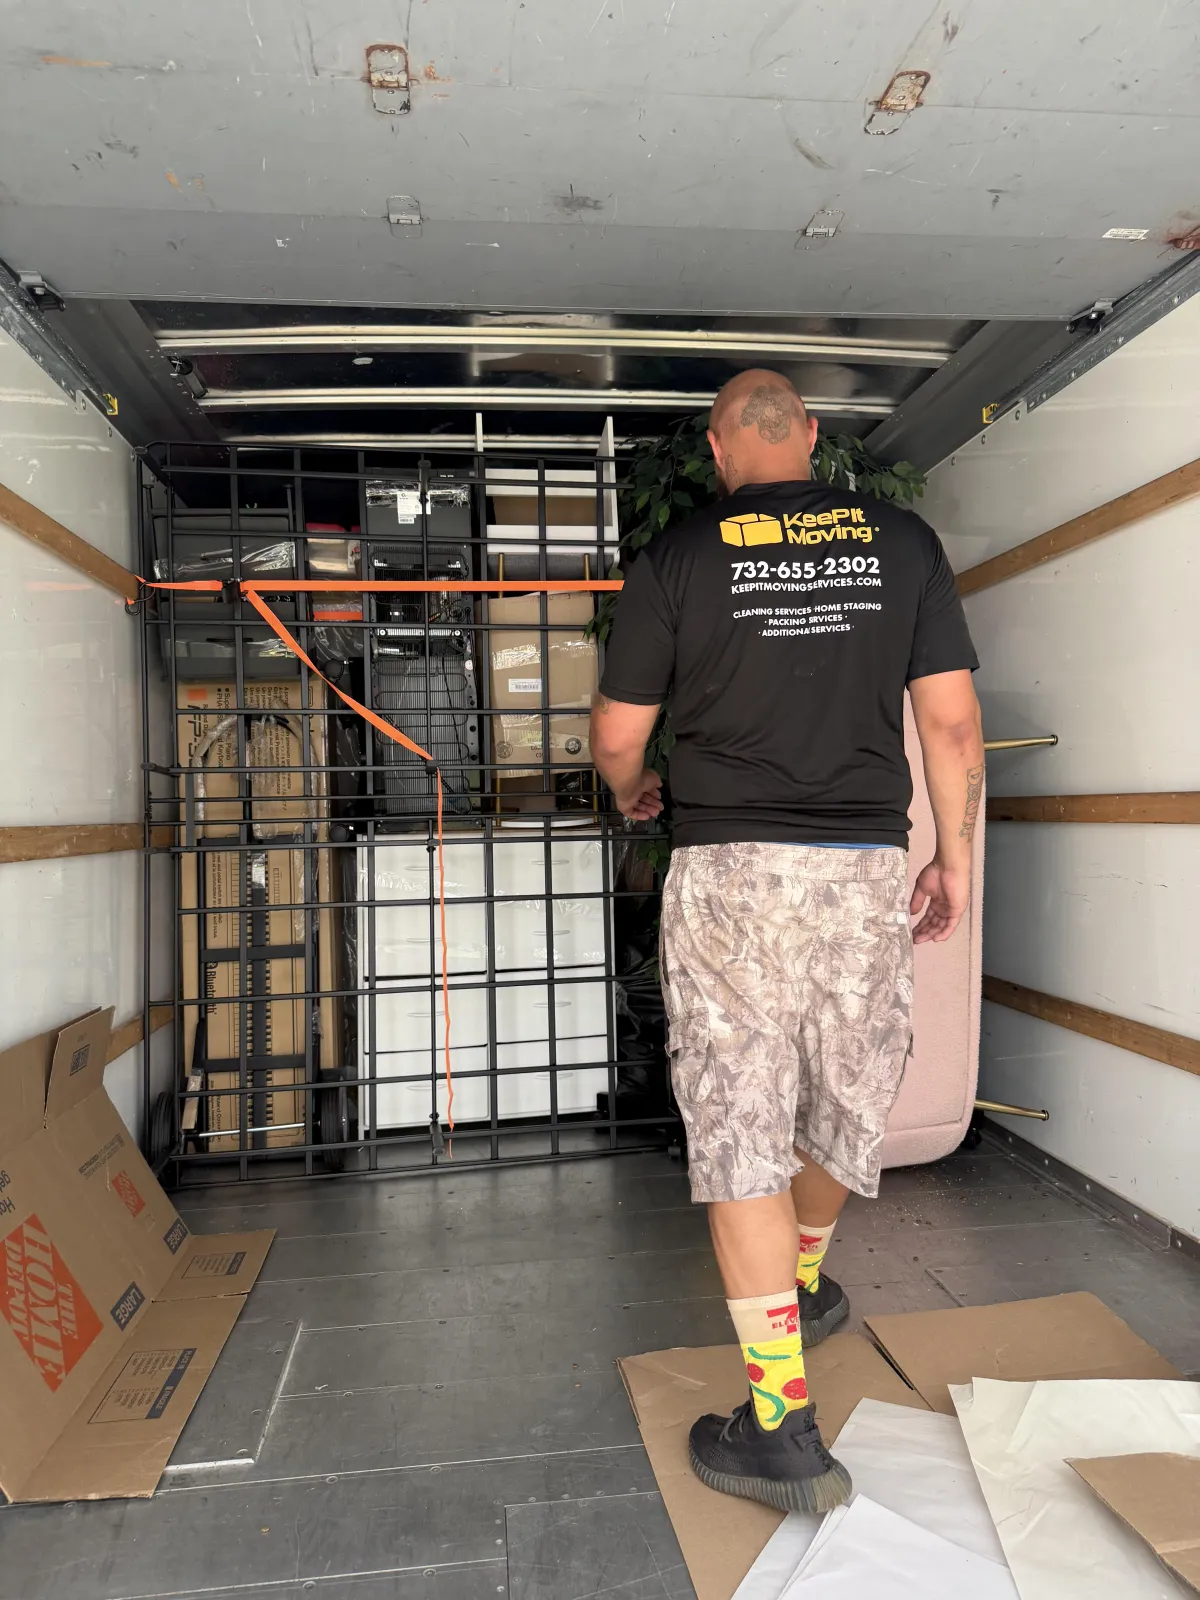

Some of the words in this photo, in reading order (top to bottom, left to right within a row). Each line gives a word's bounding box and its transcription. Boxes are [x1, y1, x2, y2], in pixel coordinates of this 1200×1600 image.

[731, 556, 880, 581] 732-655-2302
[731, 577, 882, 595] KEEPITMOVINGSERVICES.COM
[733, 607, 774, 619] CLEANING
[774, 606, 812, 616] SERVICES
[814, 603, 842, 613] HOME
[843, 602, 882, 611] STAGING
[768, 616, 807, 626] PACKING
[810, 624, 851, 634] SERVICES
[4, 1238, 30, 1341] DEPOT
[23, 1222, 66, 1381] HOME
[57, 1283, 79, 1340] THE
[115, 1286, 144, 1325] LARGE
